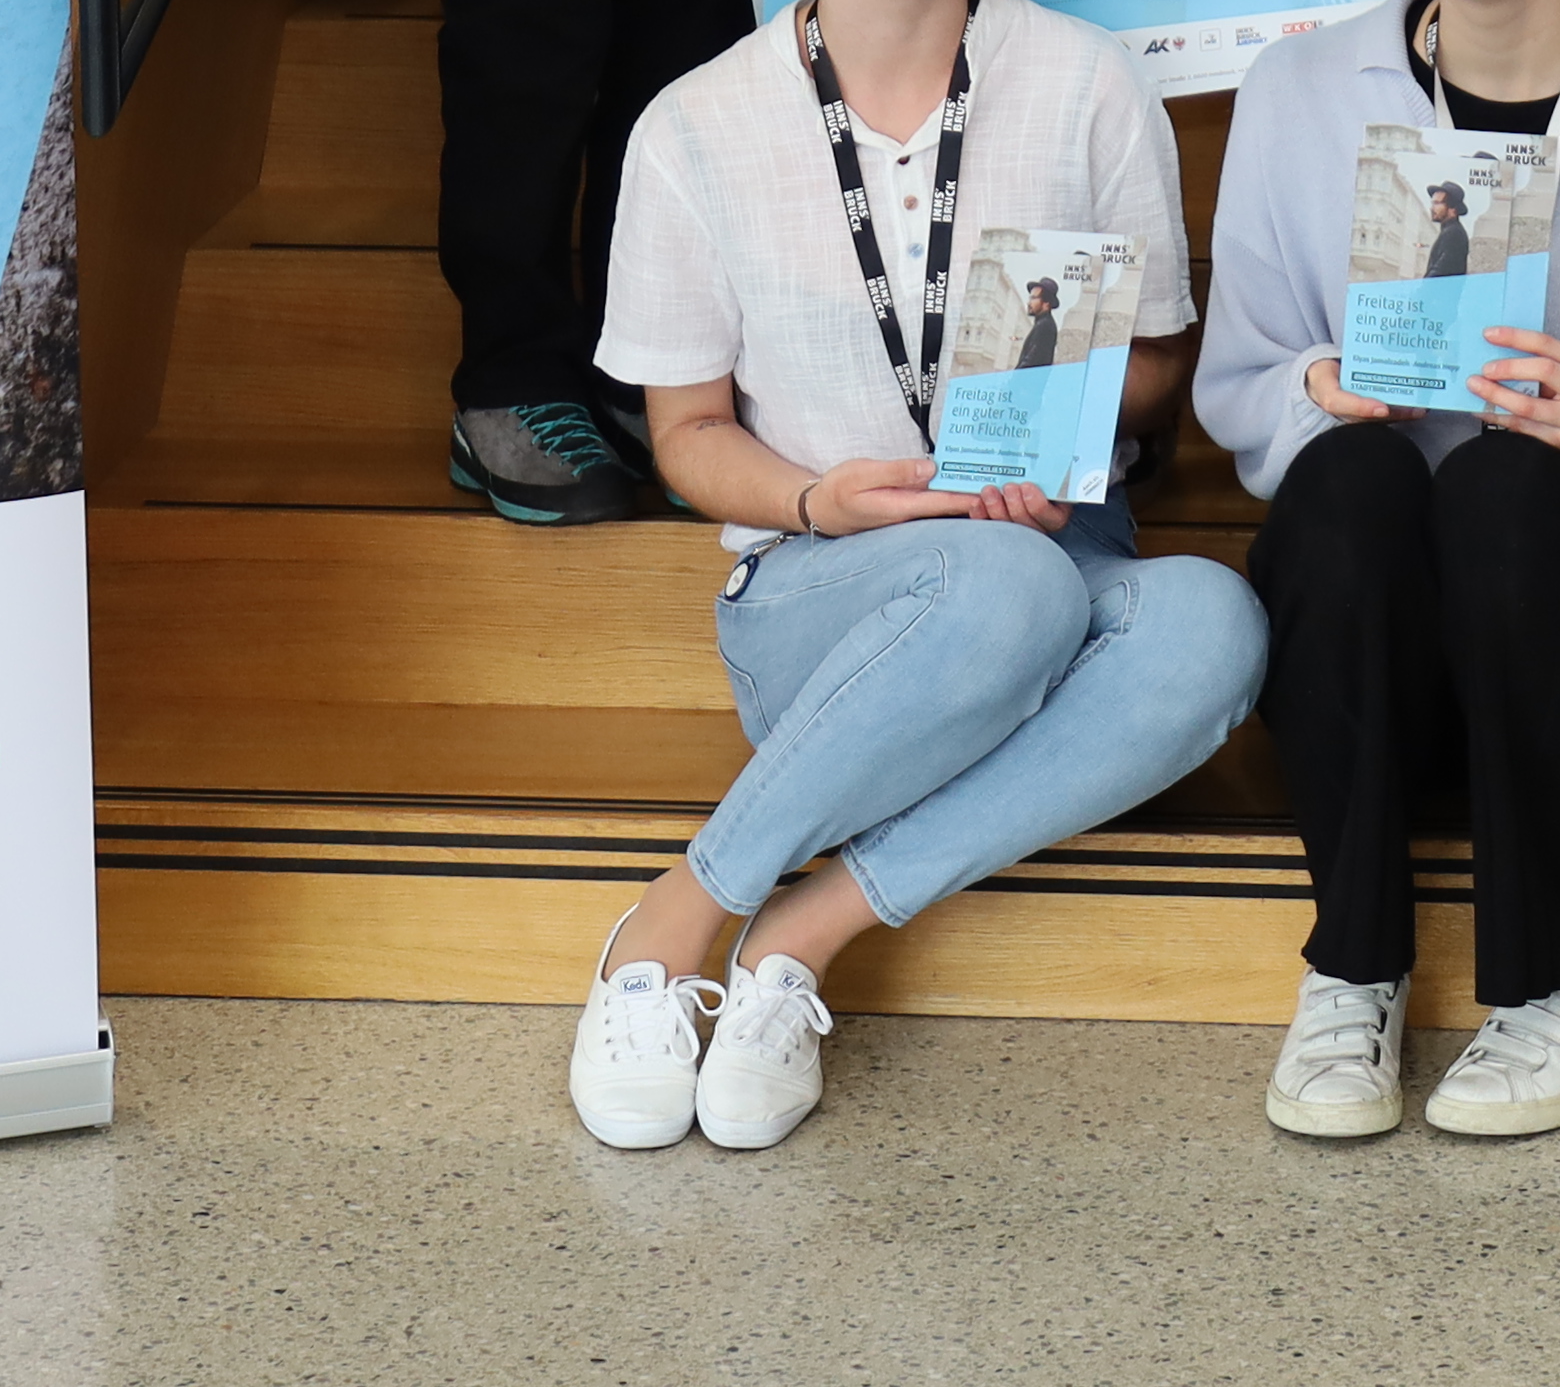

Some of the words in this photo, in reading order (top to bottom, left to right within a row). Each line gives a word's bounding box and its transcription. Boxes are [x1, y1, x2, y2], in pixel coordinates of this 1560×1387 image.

[823, 103, 842, 144] BRUCK
[843, 189, 862, 233] BRUCK
[942, 180, 957, 223] BRUCK
[867, 278, 888, 320] BRUCK
[935, 270, 948, 315] BRUCK
[1357, 293, 1404, 314] Freitag
[1408, 297, 1424, 313] ist
[1356, 313, 1377, 326] ein
[1380, 315, 1416, 331] guter
[1420, 317, 1444, 336] Tag
[1355, 332, 1384, 345] zum
[1388, 330, 1449, 351] Flüchten
[954, 387, 995, 405] Freitag
[997, 389, 1012, 403] ist
[952, 405, 970, 418] ein
[972, 407, 1004, 423] guter
[1008, 407, 1028, 424] Tag
[949, 422, 974, 435] zum
[978, 421, 1031, 439] Flüchten
[623, 980, 648, 992] Keds
